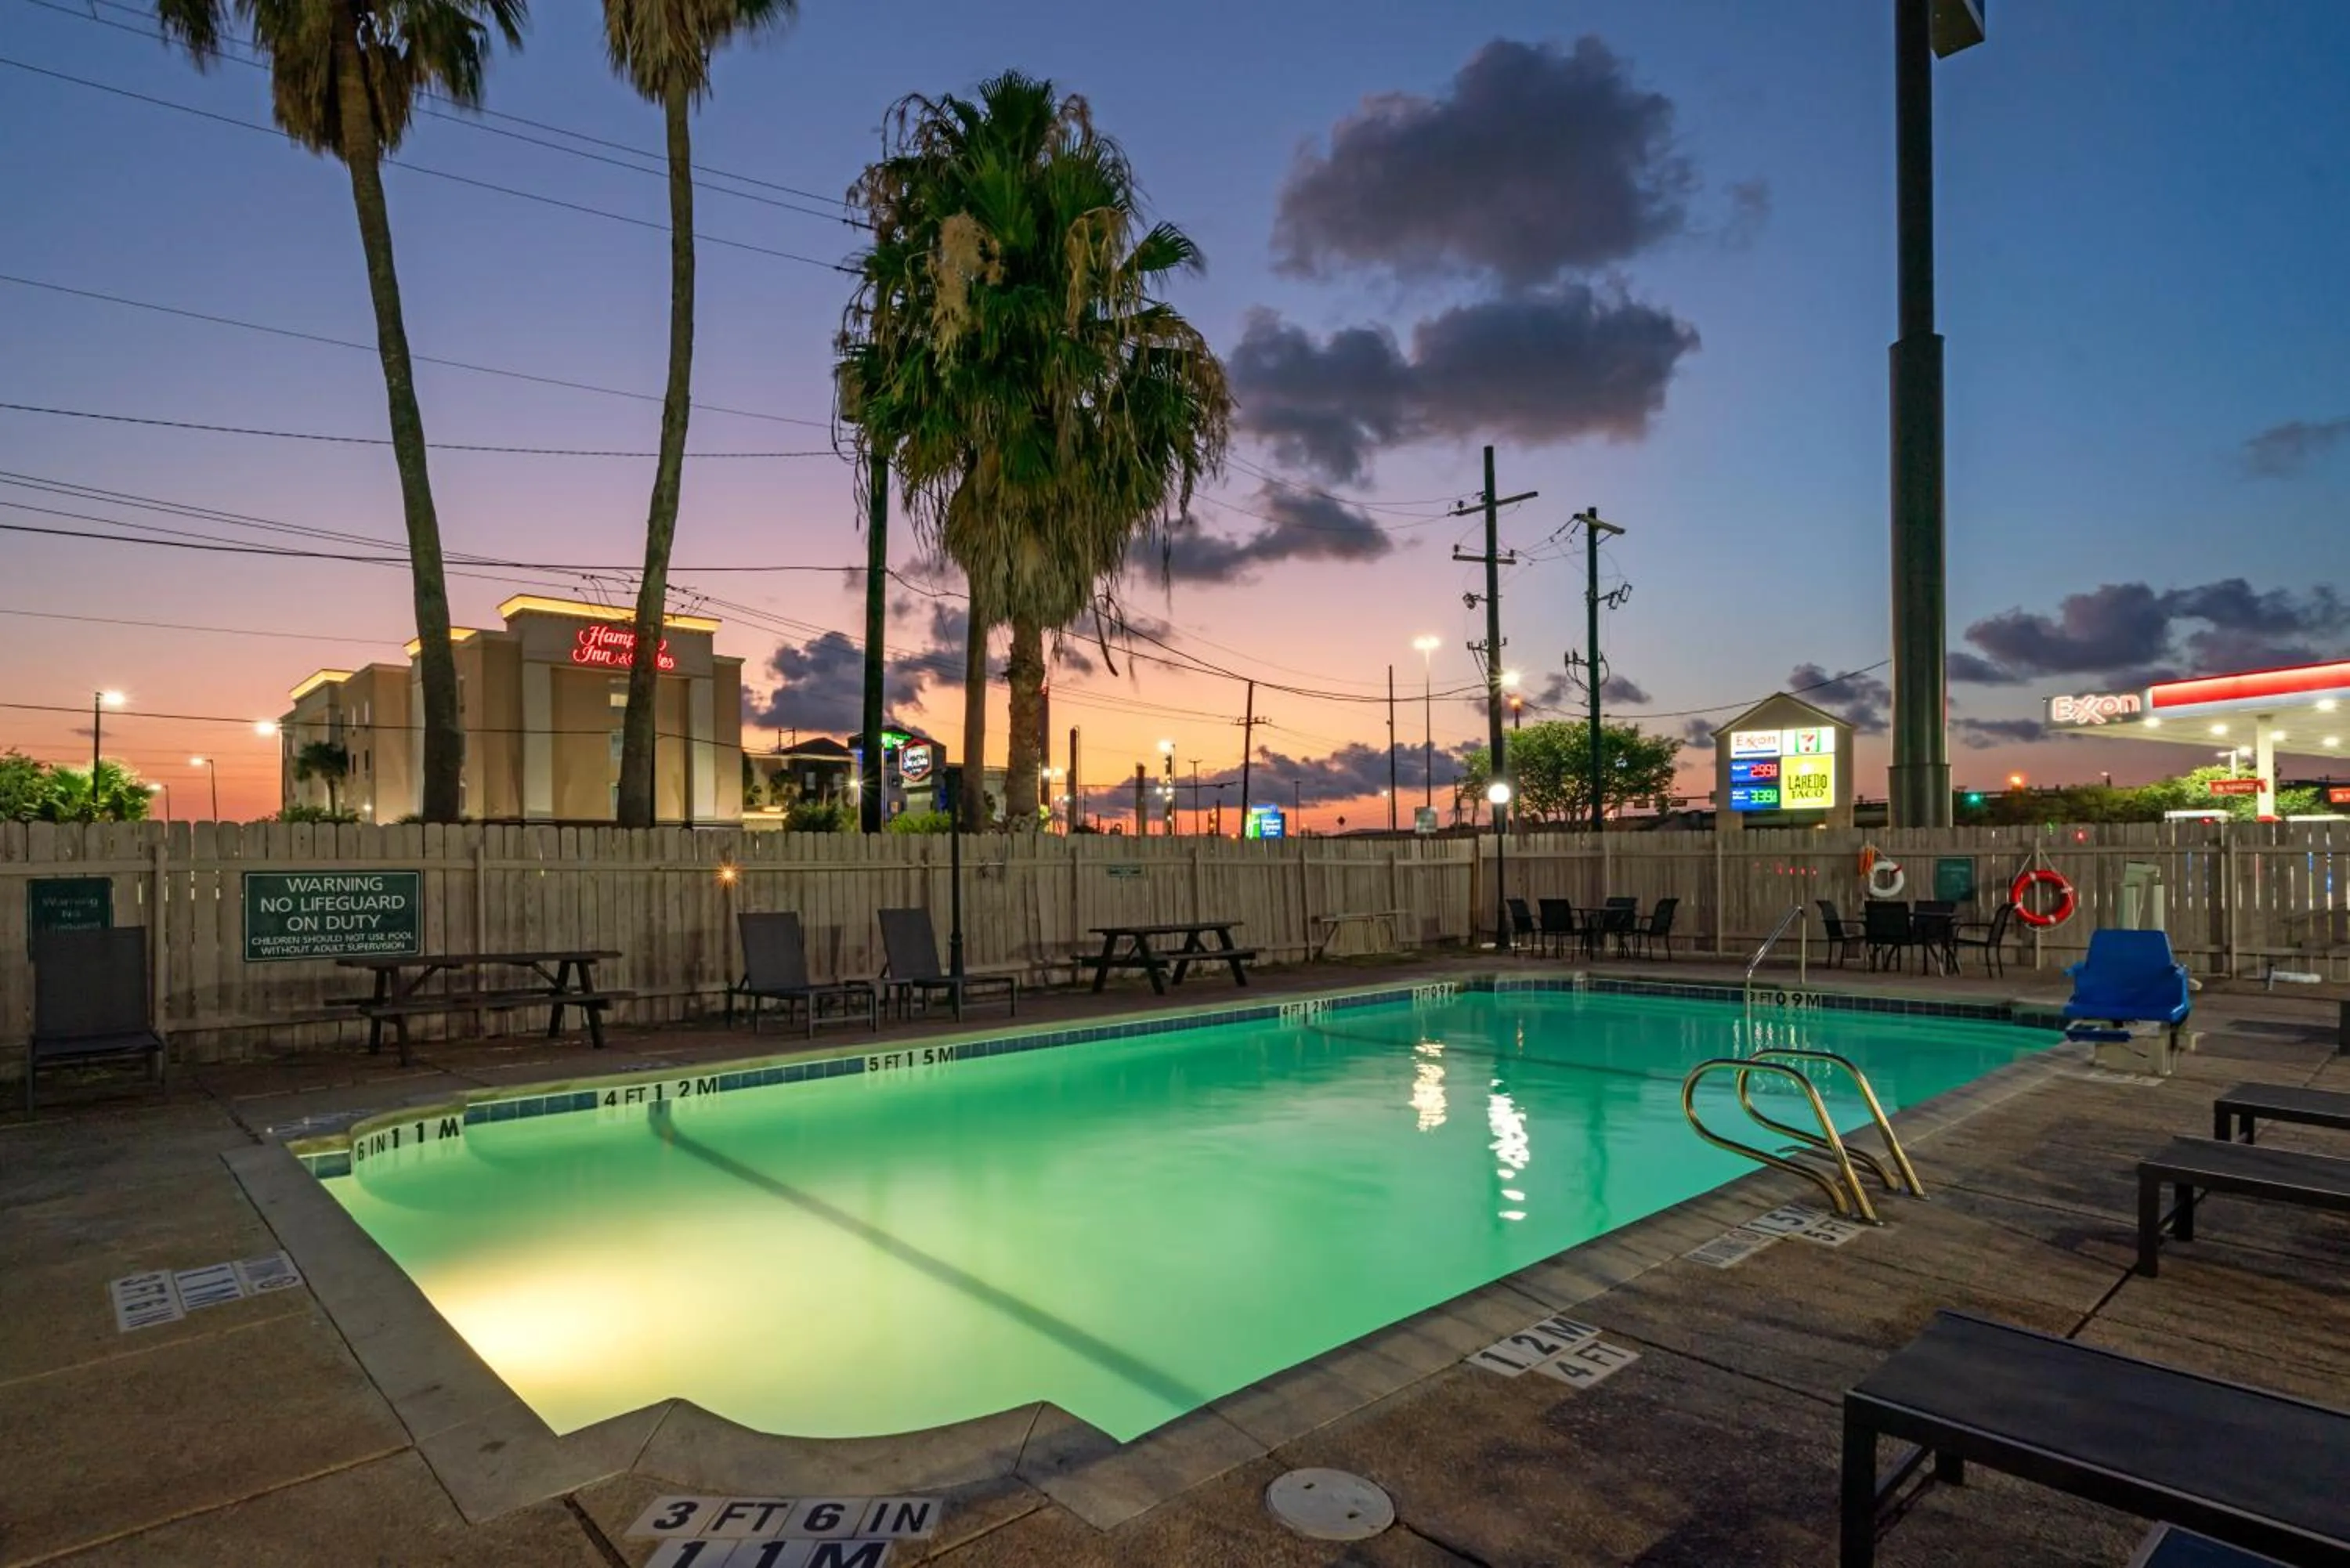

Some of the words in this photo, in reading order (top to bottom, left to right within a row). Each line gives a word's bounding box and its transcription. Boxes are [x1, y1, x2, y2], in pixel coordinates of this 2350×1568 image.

[573, 645, 617, 665] Inn
[2052, 695, 2141, 724] Exxon
[1736, 735, 1776, 749] Exxon
[1788, 774, 1828, 790] LAREDO
[1791, 789, 1824, 799] TACO
[286, 876, 383, 892] WARNING
[260, 898, 293, 912] NO
[300, 895, 406, 912] LIFEGUARD
[287, 916, 319, 931] ON
[326, 914, 381, 930] DUTY
[251, 935, 300, 945] CHILDREN
[302, 934, 342, 944] SHOULD
[345, 933, 365, 941] NOT
[367, 932, 385, 941] USE
[388, 931, 414, 940] POOL
[261, 945, 310, 956] WITHOUT
[313, 943, 345, 953] ADULT
[347, 941, 406, 952] SUPERVISION
[869, 1057, 879, 1071] 5
[884, 1053, 902, 1070] FT
[604, 1089, 617, 1106] 4
[625, 1086, 646, 1104] FT
[371, 1135, 385, 1157] IN
[1574, 1341, 1628, 1367] FT
[1555, 1360, 1595, 1378] 4
[653, 1501, 700, 1530] 3
[710, 1502, 787, 1532] FT
[803, 1502, 845, 1532] 6
[869, 1502, 931, 1533] IN
